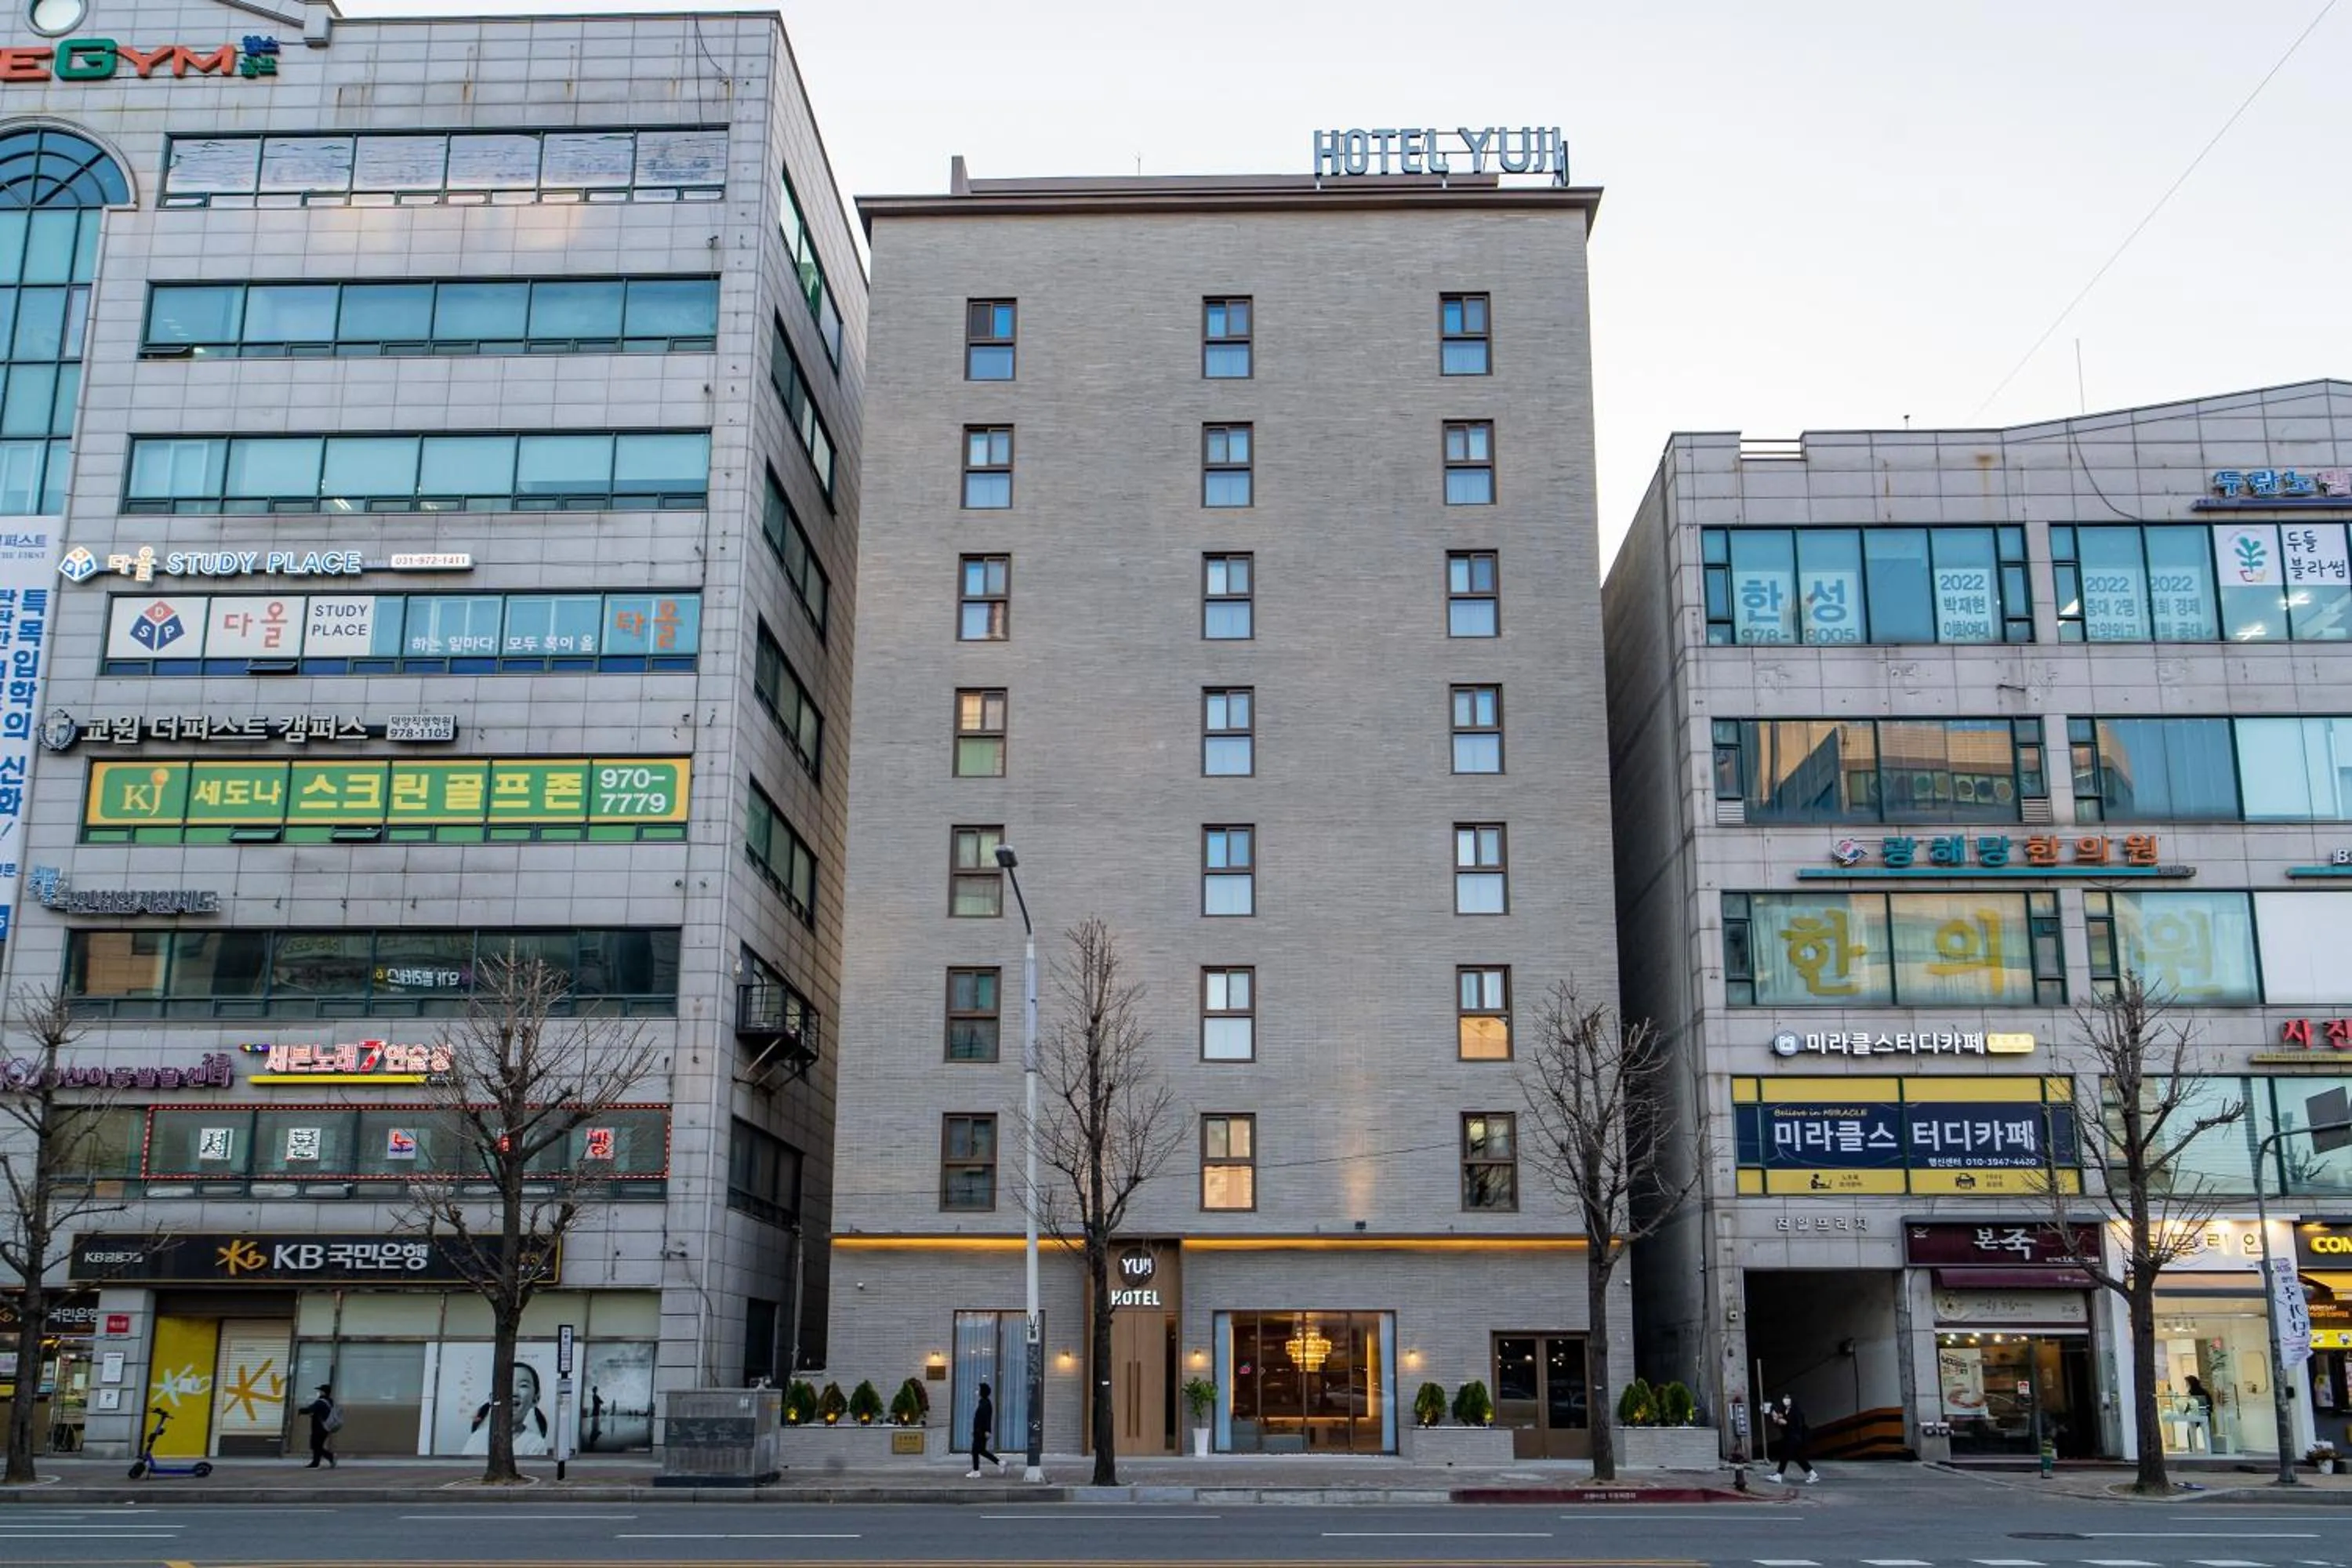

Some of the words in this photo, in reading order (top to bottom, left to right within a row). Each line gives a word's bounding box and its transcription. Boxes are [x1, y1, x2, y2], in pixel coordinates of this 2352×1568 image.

[1314, 129, 1449, 174] HOTEL
[1457, 127, 1563, 173] YUJI
[0, 534, 46, 547] 퍼스트
[2288, 529, 2317, 553] 두들
[167, 553, 256, 574] STUDY
[267, 553, 361, 575] PLACE
[2289, 559, 2345, 581] 블라썸
[1940, 574, 1984, 590] 2022
[2085, 576, 2129, 592] 2022
[155, 607, 164, 619] D
[315, 604, 368, 617] STUDY
[138, 625, 150, 637] S
[164, 626, 174, 639] P
[224, 601, 288, 648] 다올
[313, 623, 367, 636] PLACE
[82, 714, 143, 743] 교원
[150, 714, 267, 741] 더퍼스트
[278, 714, 368, 742] 캠퍼스
[390, 728, 450, 738] 978-1105
[194, 780, 281, 805] 세도나
[300, 773, 429, 810] 스크린
[445, 773, 583, 810] 골프존
[600, 792, 666, 813] 7779
[2024, 833, 2158, 866] 한의원
[1806, 1032, 1984, 1054] 미라클스터디카페
[1774, 1120, 2037, 1152] 미라클스터디카페
[1973, 1228, 2037, 1261] 본죽
[1111, 1290, 1160, 1305] HOTEL
